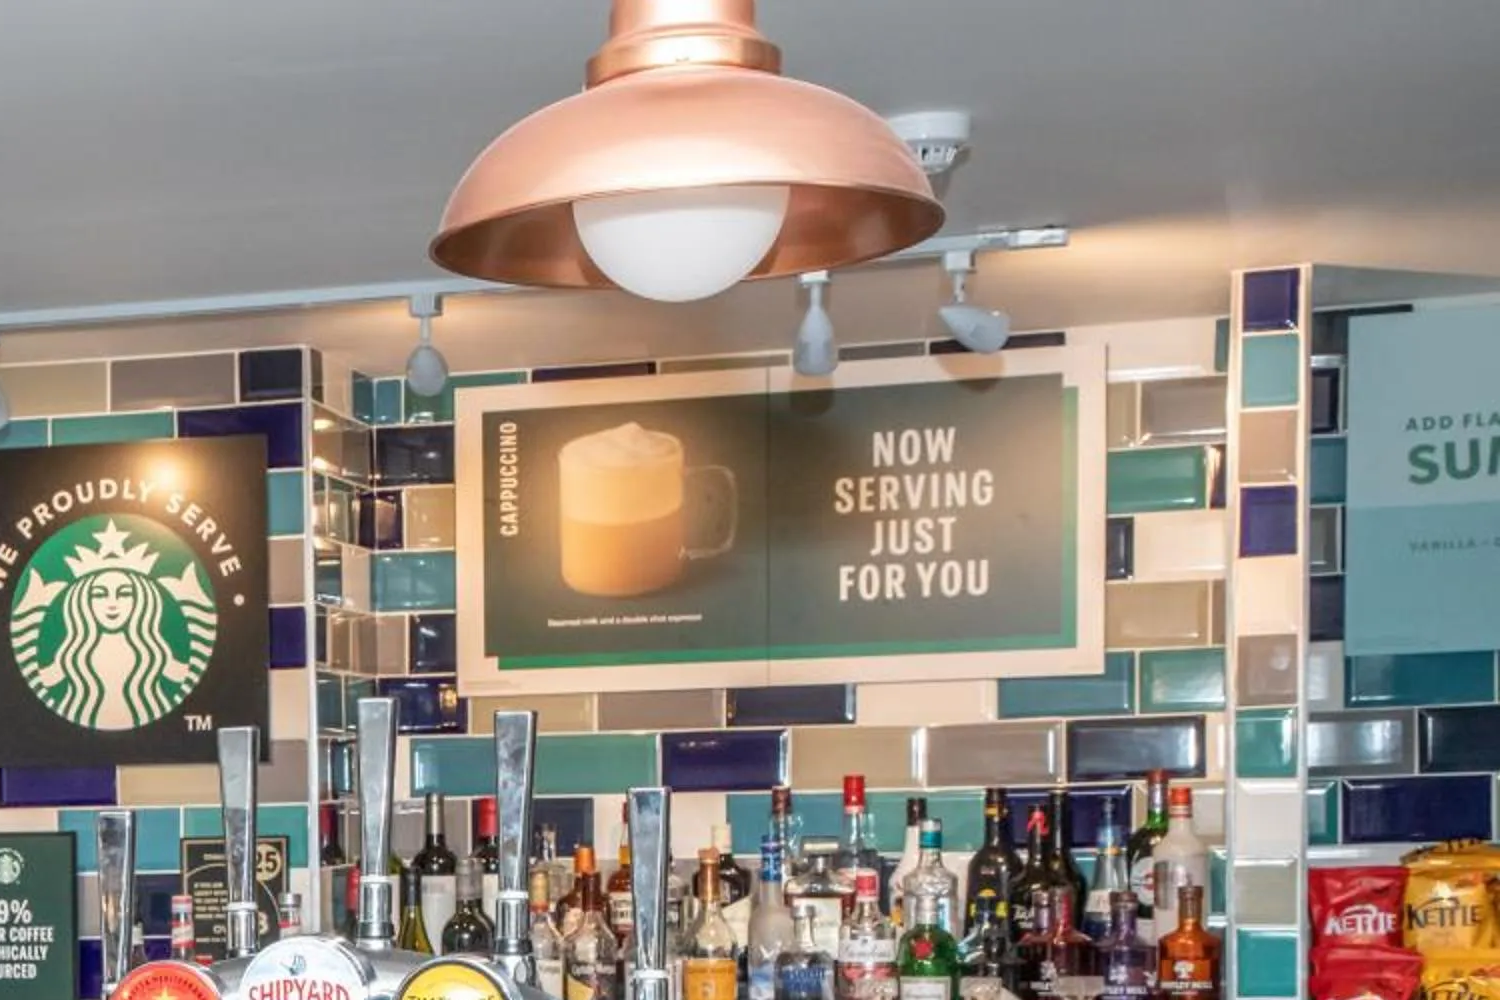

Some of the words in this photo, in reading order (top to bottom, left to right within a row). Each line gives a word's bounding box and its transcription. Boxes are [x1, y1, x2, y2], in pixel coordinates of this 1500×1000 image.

[1406, 415, 1454, 432] ADD
[1462, 411, 1500, 429] FLA
[871, 427, 957, 467] NOW
[500, 421, 518, 537] CAPPUCCINO
[834, 470, 994, 514] SERVING
[16, 477, 159, 539] PROUDLY
[165, 494, 242, 577] SERVE
[870, 516, 957, 556] JUST
[839, 563, 905, 601] FOR
[915, 559, 990, 598] YOU
[184, 715, 213, 731] TM
[1406, 897, 1484, 930] KETTLE
[9, 926, 54, 942] COFFEE
